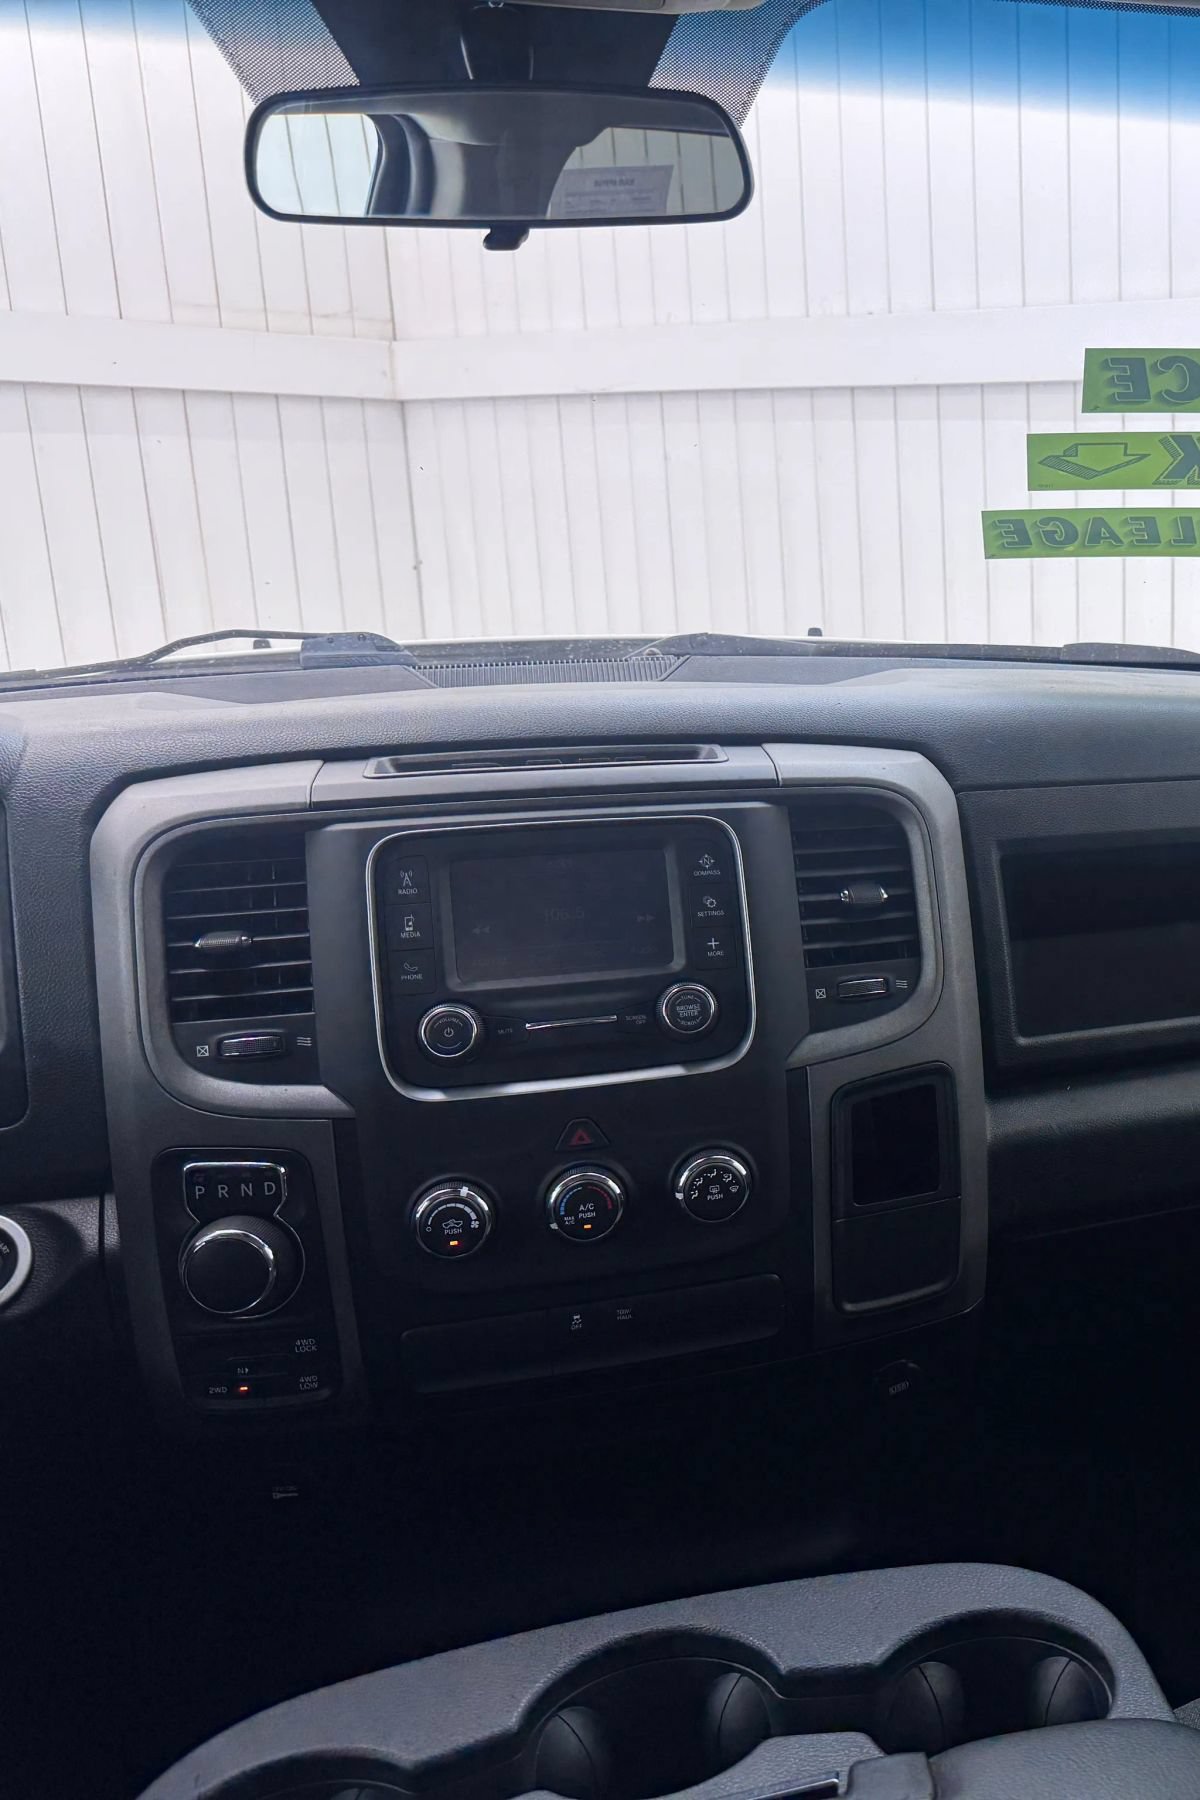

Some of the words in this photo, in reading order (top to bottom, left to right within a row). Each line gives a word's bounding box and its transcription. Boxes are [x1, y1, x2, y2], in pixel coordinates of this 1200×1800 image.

[400, 930, 421, 938] MEDIA
[195, 1186, 205, 1200] P
[217, 1184, 229, 1199] R
[241, 1183, 253, 1197] N
[264, 1181, 276, 1195] D
[706, 1193, 724, 1201] PUSH
[579, 1202, 595, 1211] A/C
[578, 1211, 596, 1219] PUSH
[208, 1386, 228, 1394] 2WD
